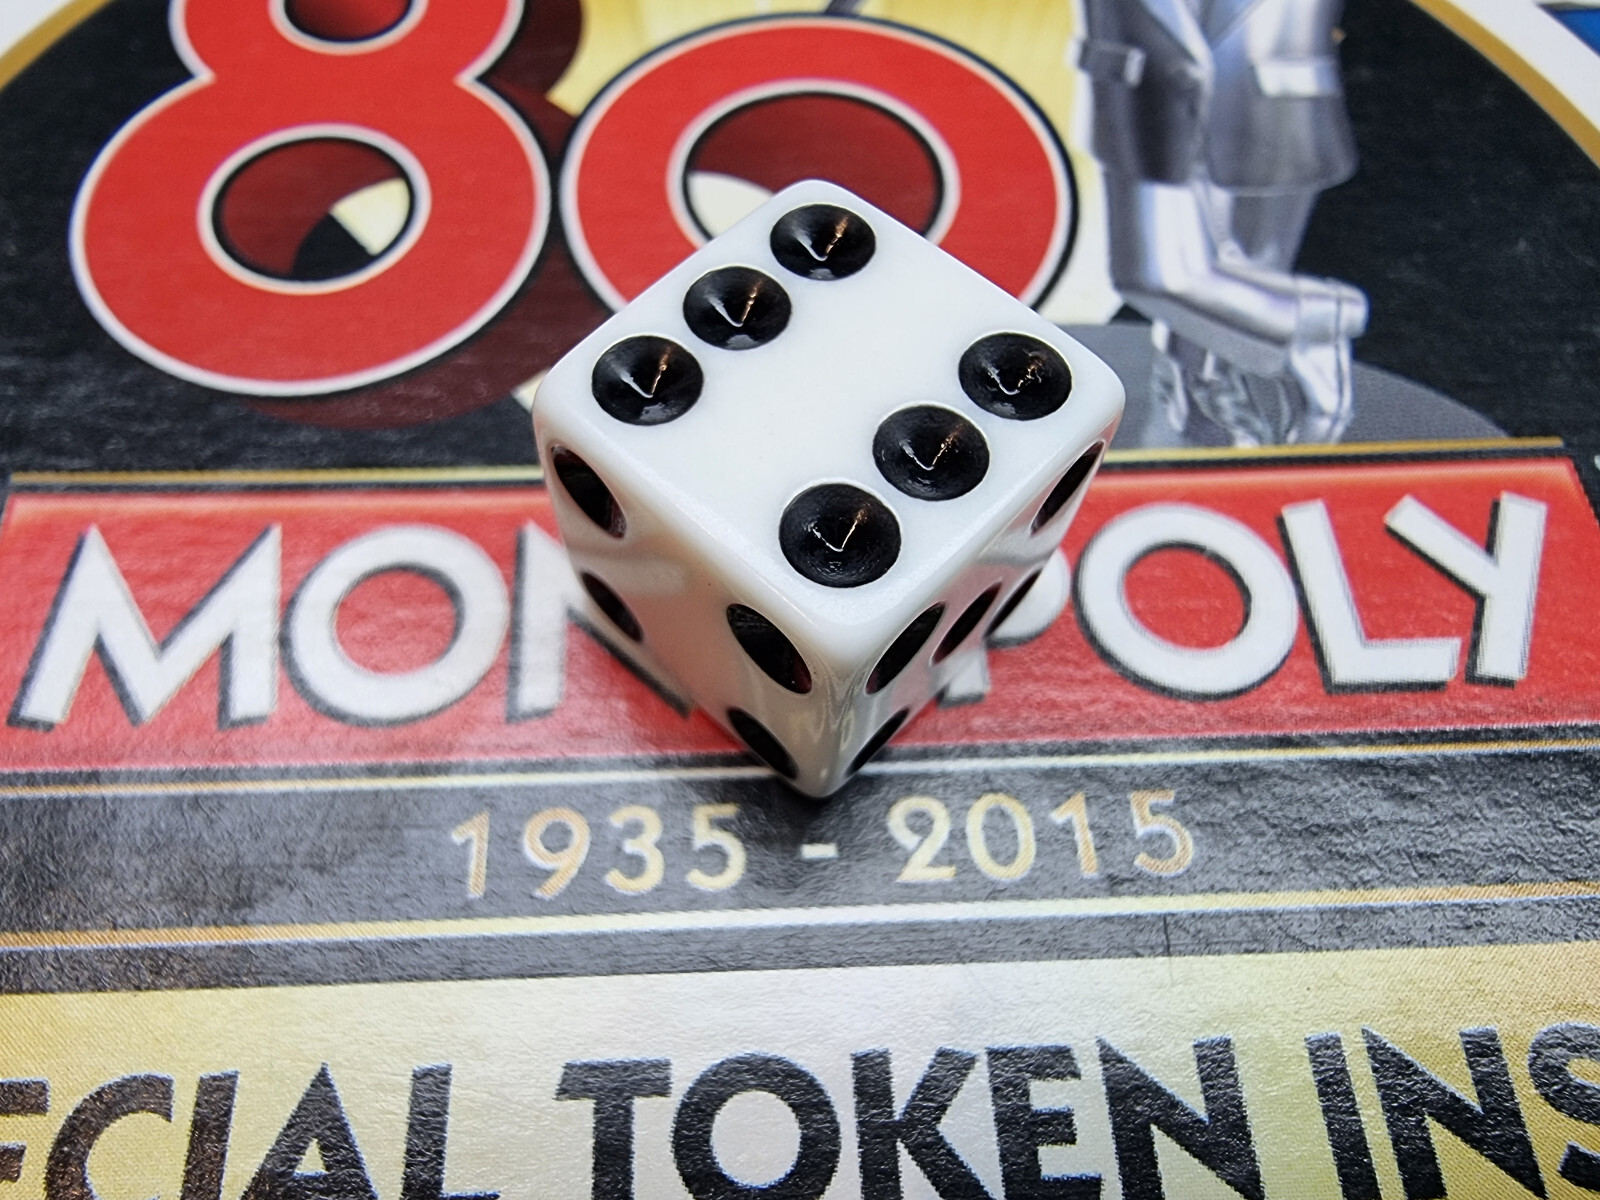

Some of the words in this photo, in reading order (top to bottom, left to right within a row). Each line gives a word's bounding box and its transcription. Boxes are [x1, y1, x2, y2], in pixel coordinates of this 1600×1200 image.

[70, 0, 1078, 397] 80
[8, 492, 1548, 729] MOOLY
[452, 802, 747, 900] 1935
[801, 843, 839, 859] -
[886, 790, 1195, 884] 2015
[554, 1033, 1266, 1200] TOKEN
